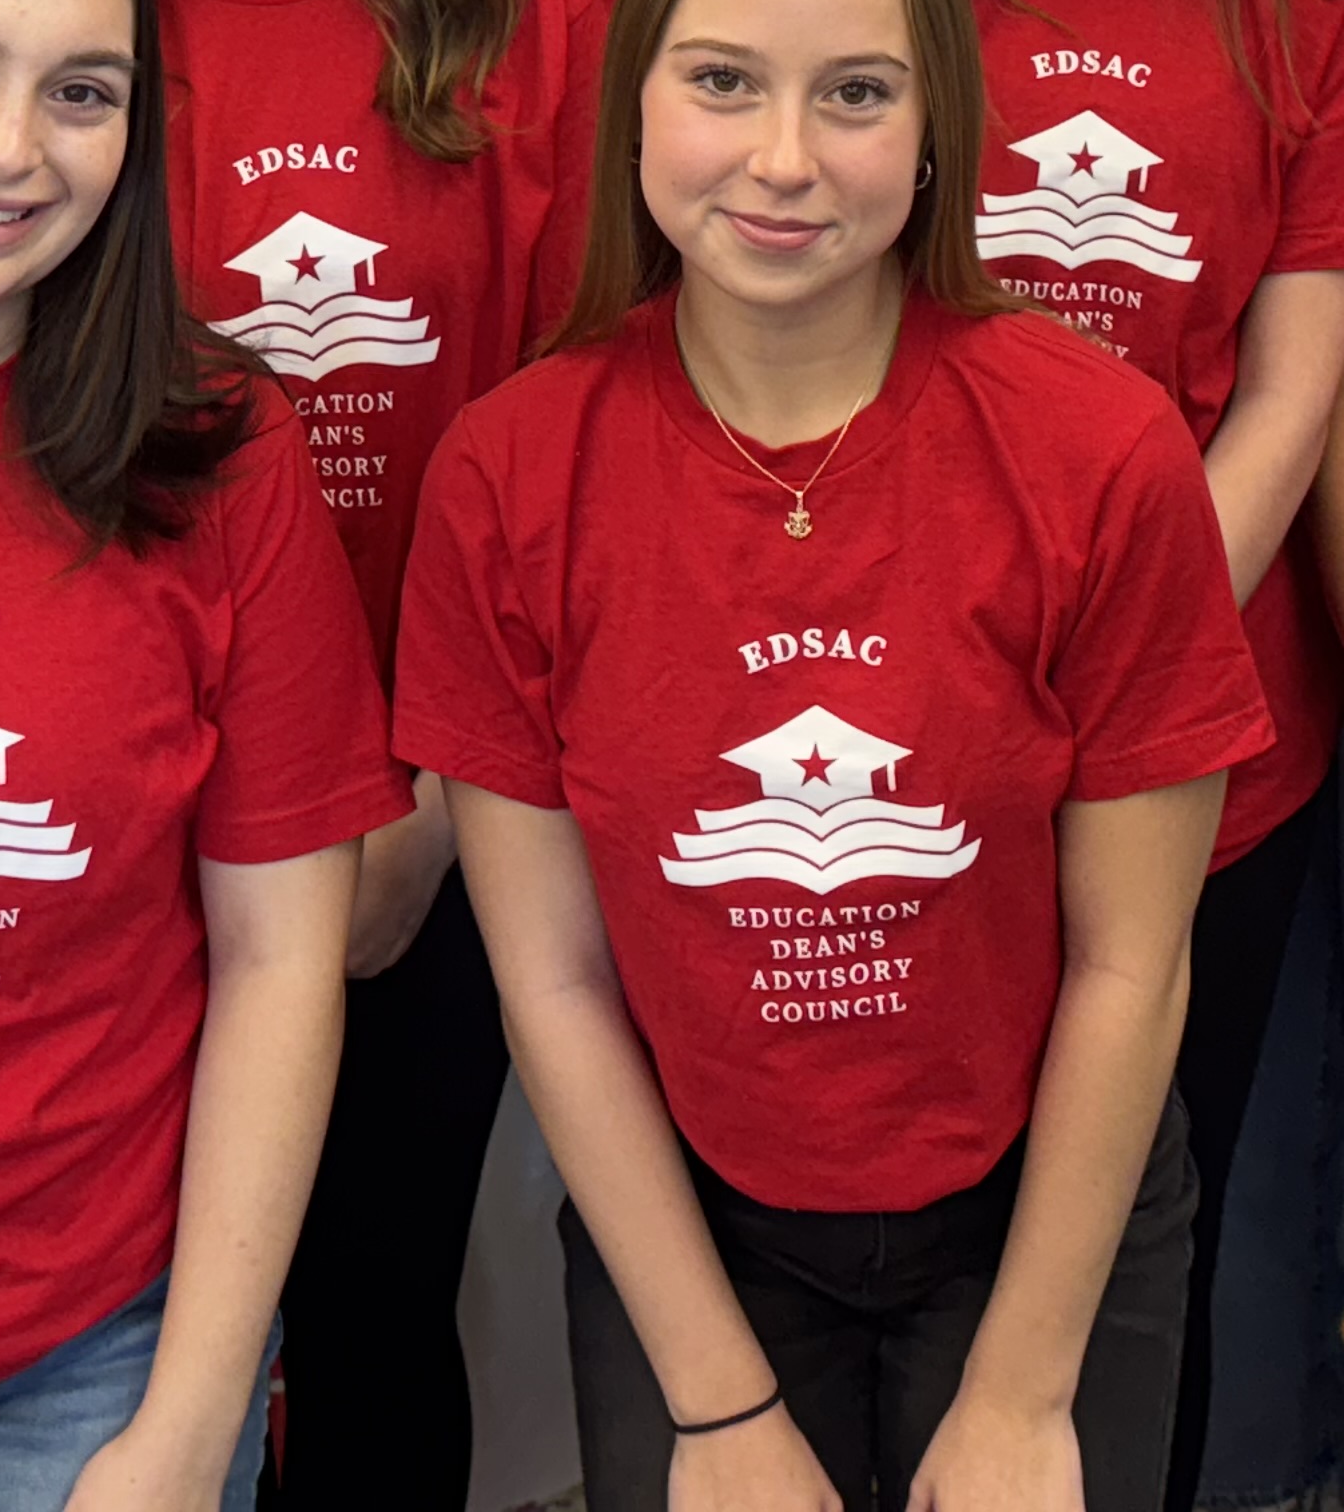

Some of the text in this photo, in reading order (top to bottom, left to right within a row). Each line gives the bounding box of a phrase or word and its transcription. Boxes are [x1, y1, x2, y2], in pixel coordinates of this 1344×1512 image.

[1031, 50, 1152, 87] EDSAC
[232, 143, 358, 185] EDSAC
[999, 278, 1143, 310] EDUCATION
[1063, 311, 1114, 331] AN'S
[295, 391, 393, 415] CATION
[309, 426, 364, 445] AN'S
[312, 455, 386, 476] SORY
[322, 488, 382, 507] NCIL
[738, 628, 887, 674] EDSAC
[728, 900, 920, 928] EDUCATION
[770, 930, 885, 959] DEAN'S
[751, 956, 912, 990] ADVISORY
[761, 992, 906, 1022] COUNCIL
